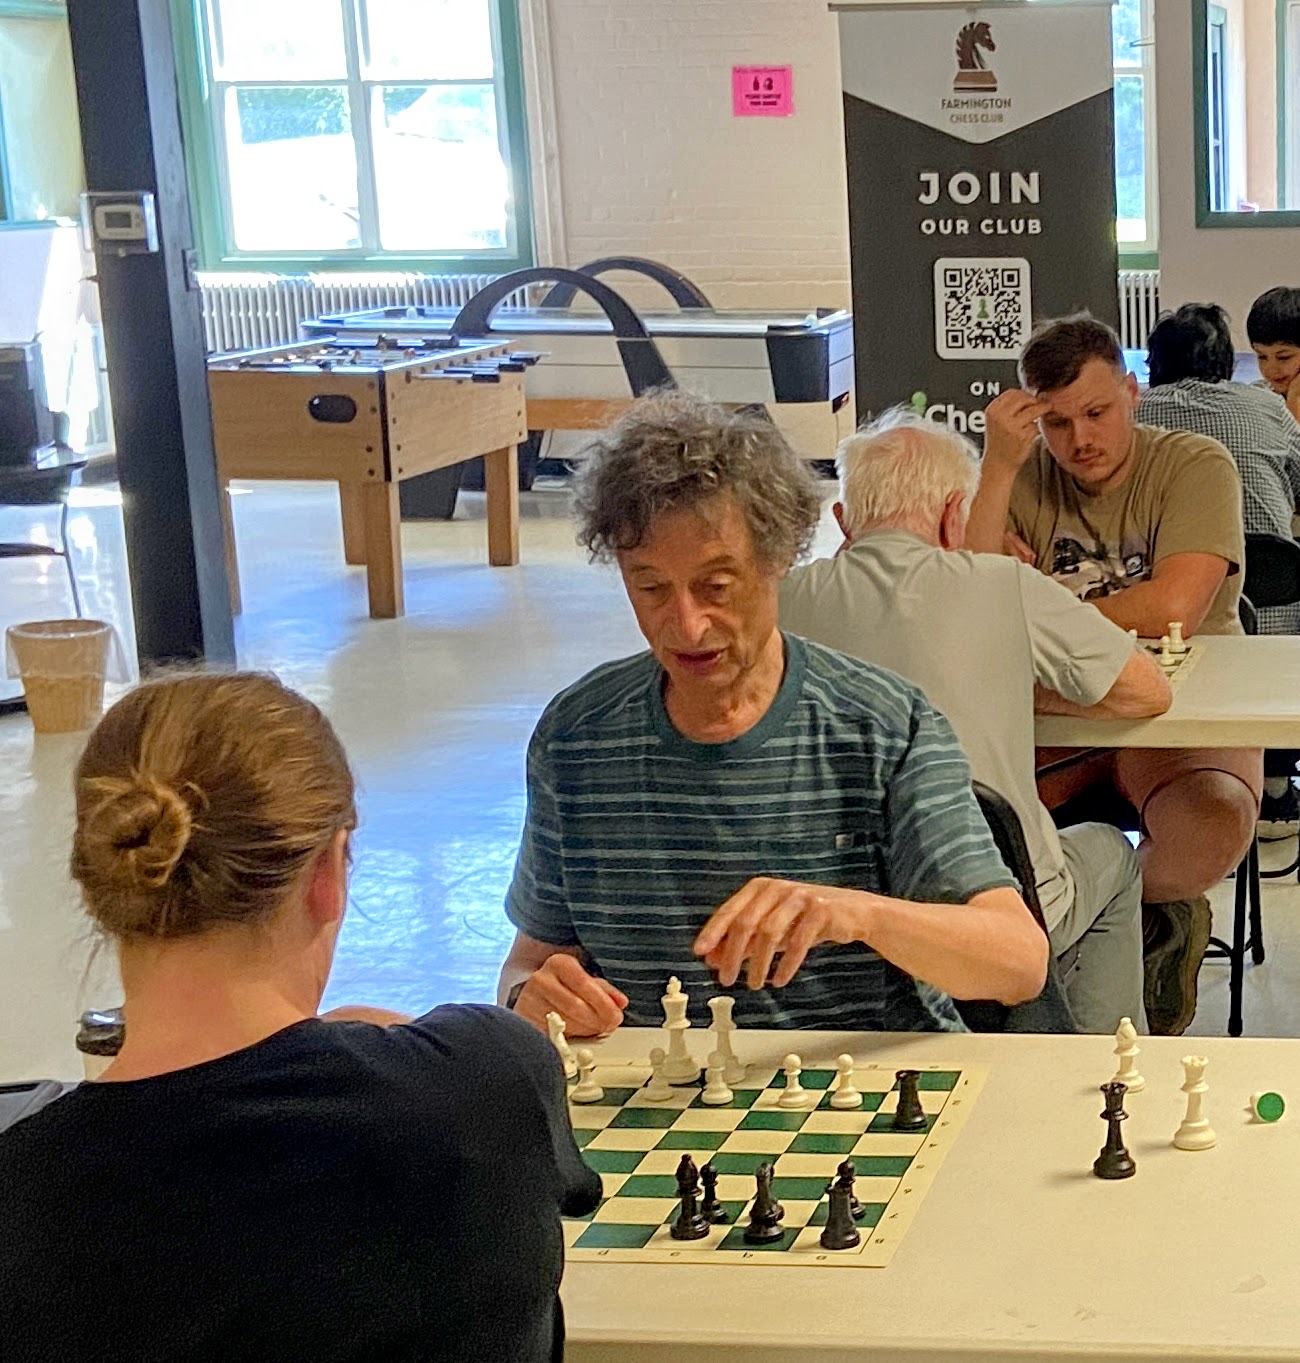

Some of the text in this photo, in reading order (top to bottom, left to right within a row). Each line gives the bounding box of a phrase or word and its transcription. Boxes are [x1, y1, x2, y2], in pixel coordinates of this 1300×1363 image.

[941, 98, 1011, 109] FARMINGTON
[950, 113, 1004, 123] CHESS CLUB
[919, 171, 1040, 205] JOIN
[920, 219, 1042, 235] OUR CLUB
[970, 381, 1000, 396] ON
[925, 404, 986, 433] Che
